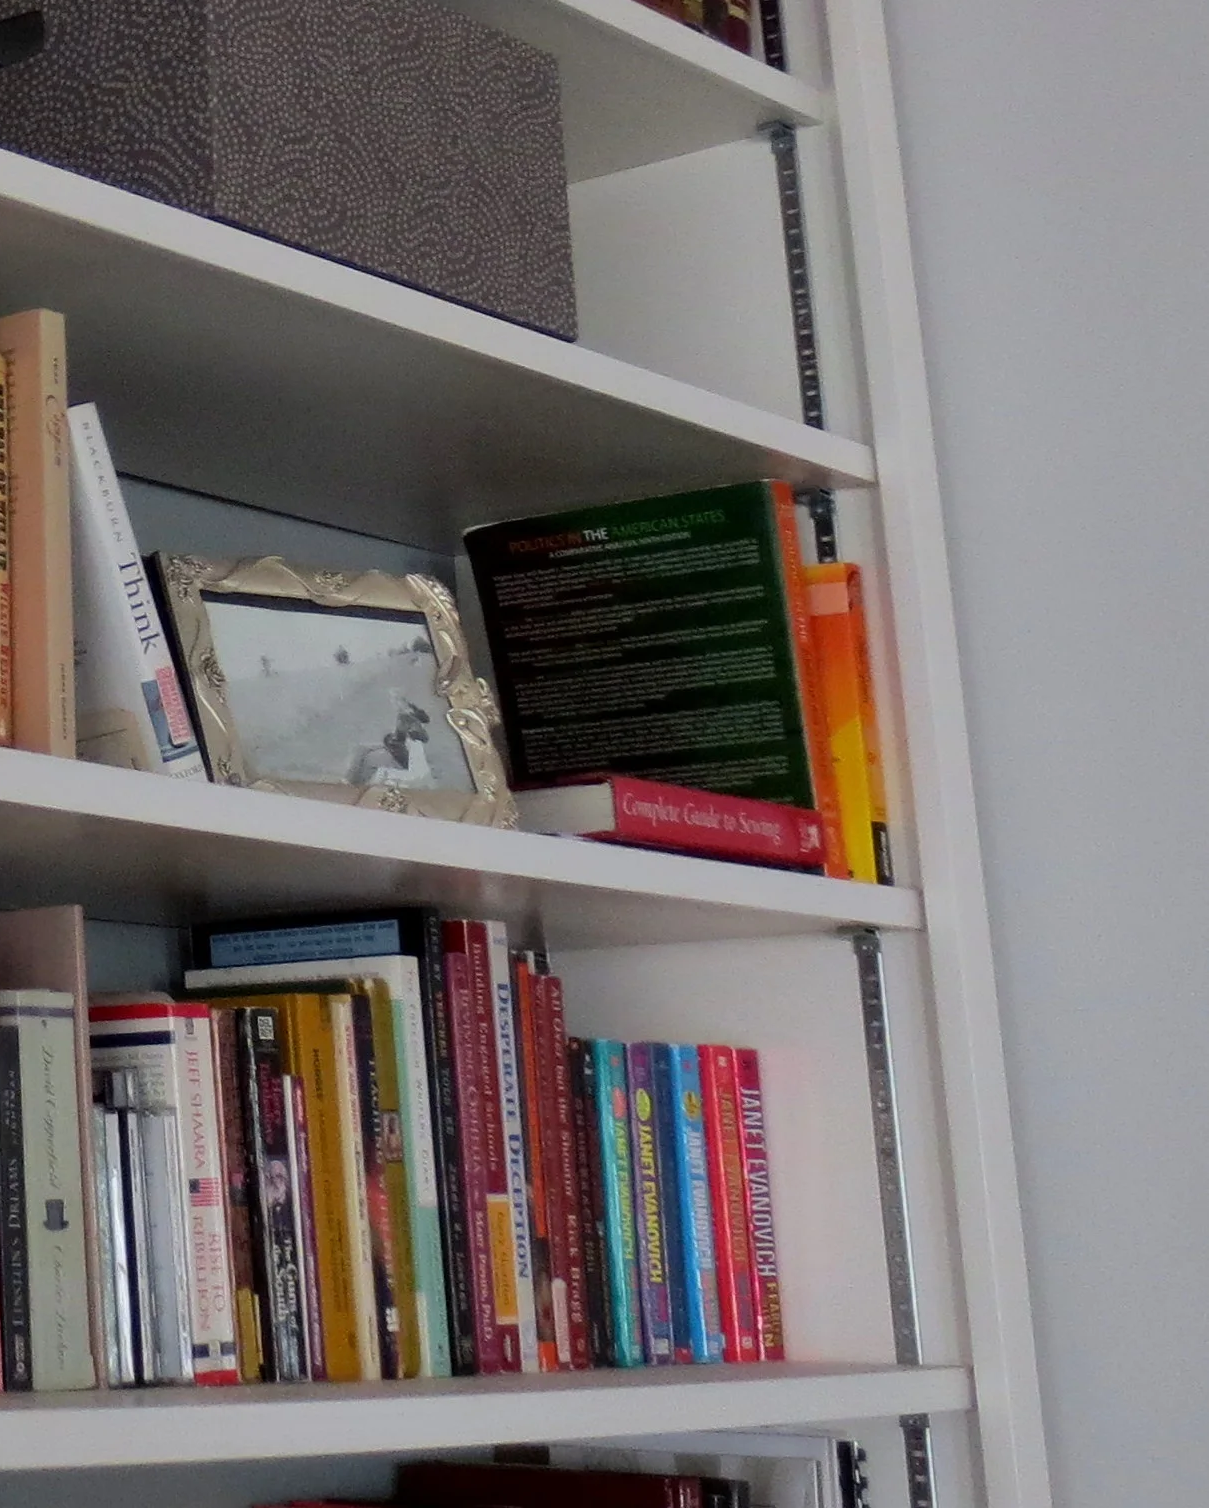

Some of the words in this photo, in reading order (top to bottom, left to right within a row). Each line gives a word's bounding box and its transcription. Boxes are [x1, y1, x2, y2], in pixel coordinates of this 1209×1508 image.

[582, 527, 610, 542] THE
[117, 553, 161, 655] Think
[622, 792, 680, 828] Complete
[682, 802, 721, 830] Guide
[722, 812, 737, 832] to
[738, 811, 782, 846] Sewing
[184, 1050, 201, 1089] JEFF
[191, 1092, 206, 1170] SHAARA
[497, 982, 518, 1126] DESPERATE
[509, 1132, 530, 1280] DECEPTION
[636, 1121, 657, 1179] JANET
[738, 1086, 769, 1152] JANET
[639, 1180, 664, 1284] EVANOVICH
[744, 1157, 777, 1278] EVANOVICH
[193, 1215, 211, 1330] REBELLION
[213, 1283, 227, 1312] TO
